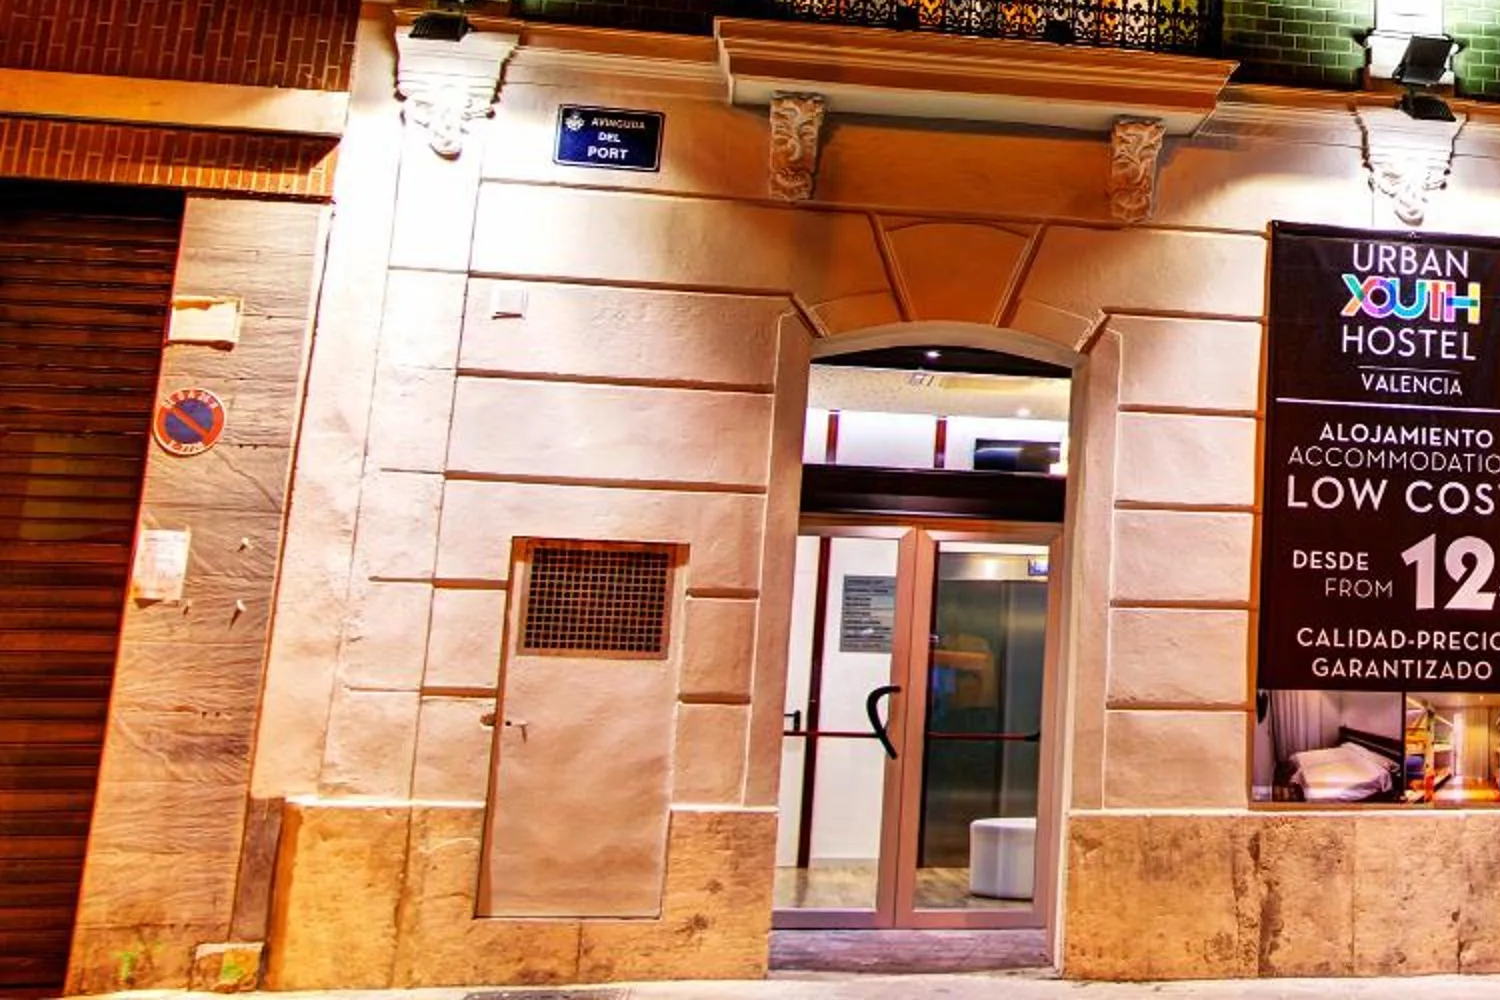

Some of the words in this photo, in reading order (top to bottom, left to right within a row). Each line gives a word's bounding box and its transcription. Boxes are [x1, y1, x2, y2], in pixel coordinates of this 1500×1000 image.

[598, 131, 621, 143] DEL
[587, 145, 629, 160] PORT
[1352, 243, 1469, 278] URBAN
[1340, 273, 1481, 325] YOUTH
[1341, 324, 1476, 361] HOSTEL
[1361, 373, 1463, 396] VALENCIA
[1319, 423, 1494, 448] ALOJAMIENTO
[1287, 475, 1387, 510] LOW
[1293, 550, 1369, 571] DESDE
[1324, 577, 1393, 599] FROM
[1311, 657, 1493, 681] GARANTIZADO
